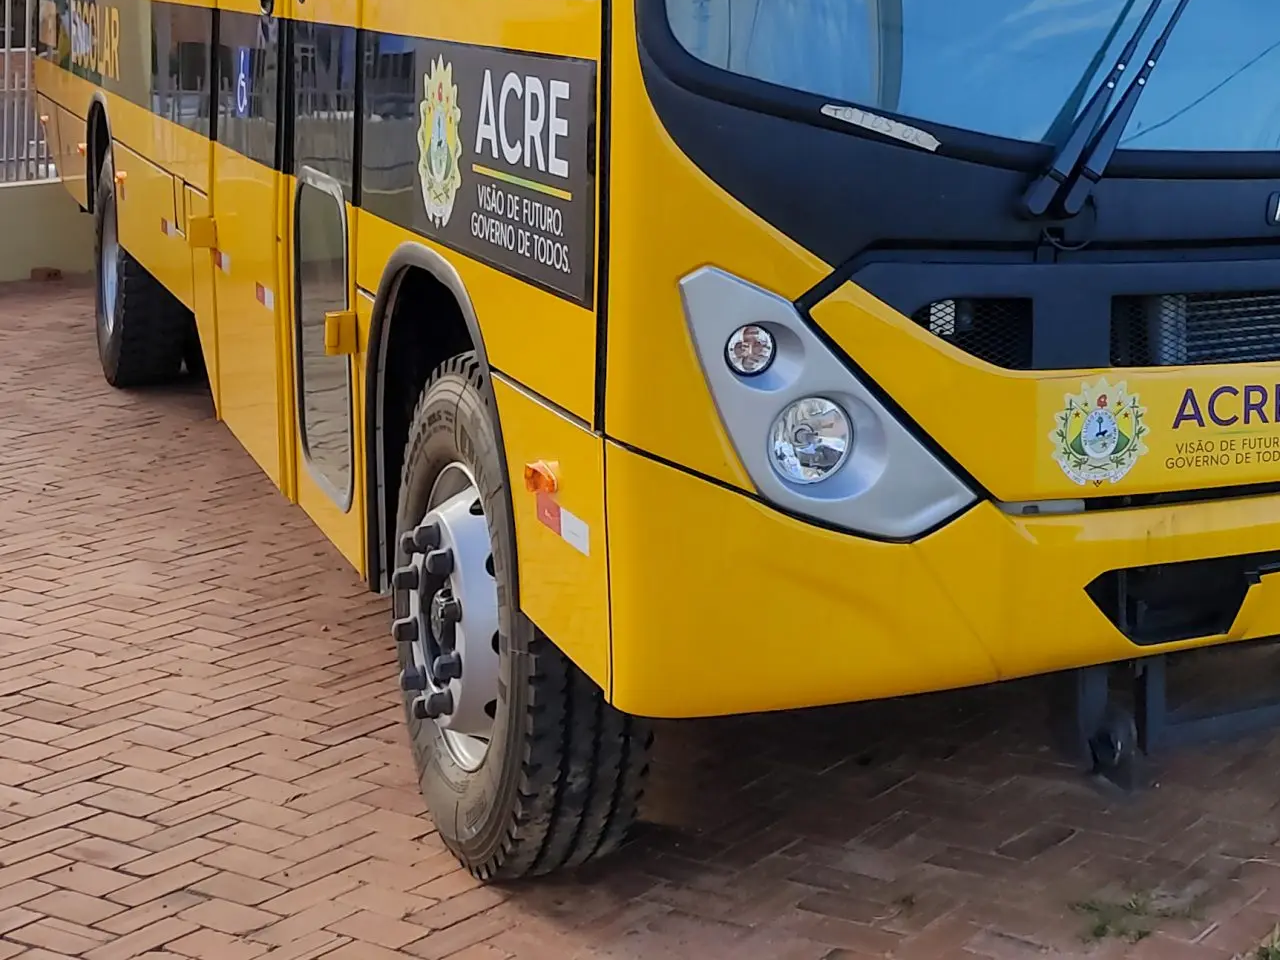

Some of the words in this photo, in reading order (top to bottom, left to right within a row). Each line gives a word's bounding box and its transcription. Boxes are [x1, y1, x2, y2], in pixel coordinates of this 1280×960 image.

[475, 69, 570, 178] ACRE
[477, 183, 504, 216] VISÃO
[507, 193, 520, 222] DE
[523, 198, 564, 237] FUTURO.
[470, 211, 515, 252] GOVERNO
[517, 229, 531, 258] DE
[533, 234, 571, 274] TODOS.
[1165, 454, 1230, 470] GOVERNO
[1235, 452, 1251, 464] DE
[1176, 440, 1214, 454] VISÃO
[1220, 440, 1236, 452] DE
